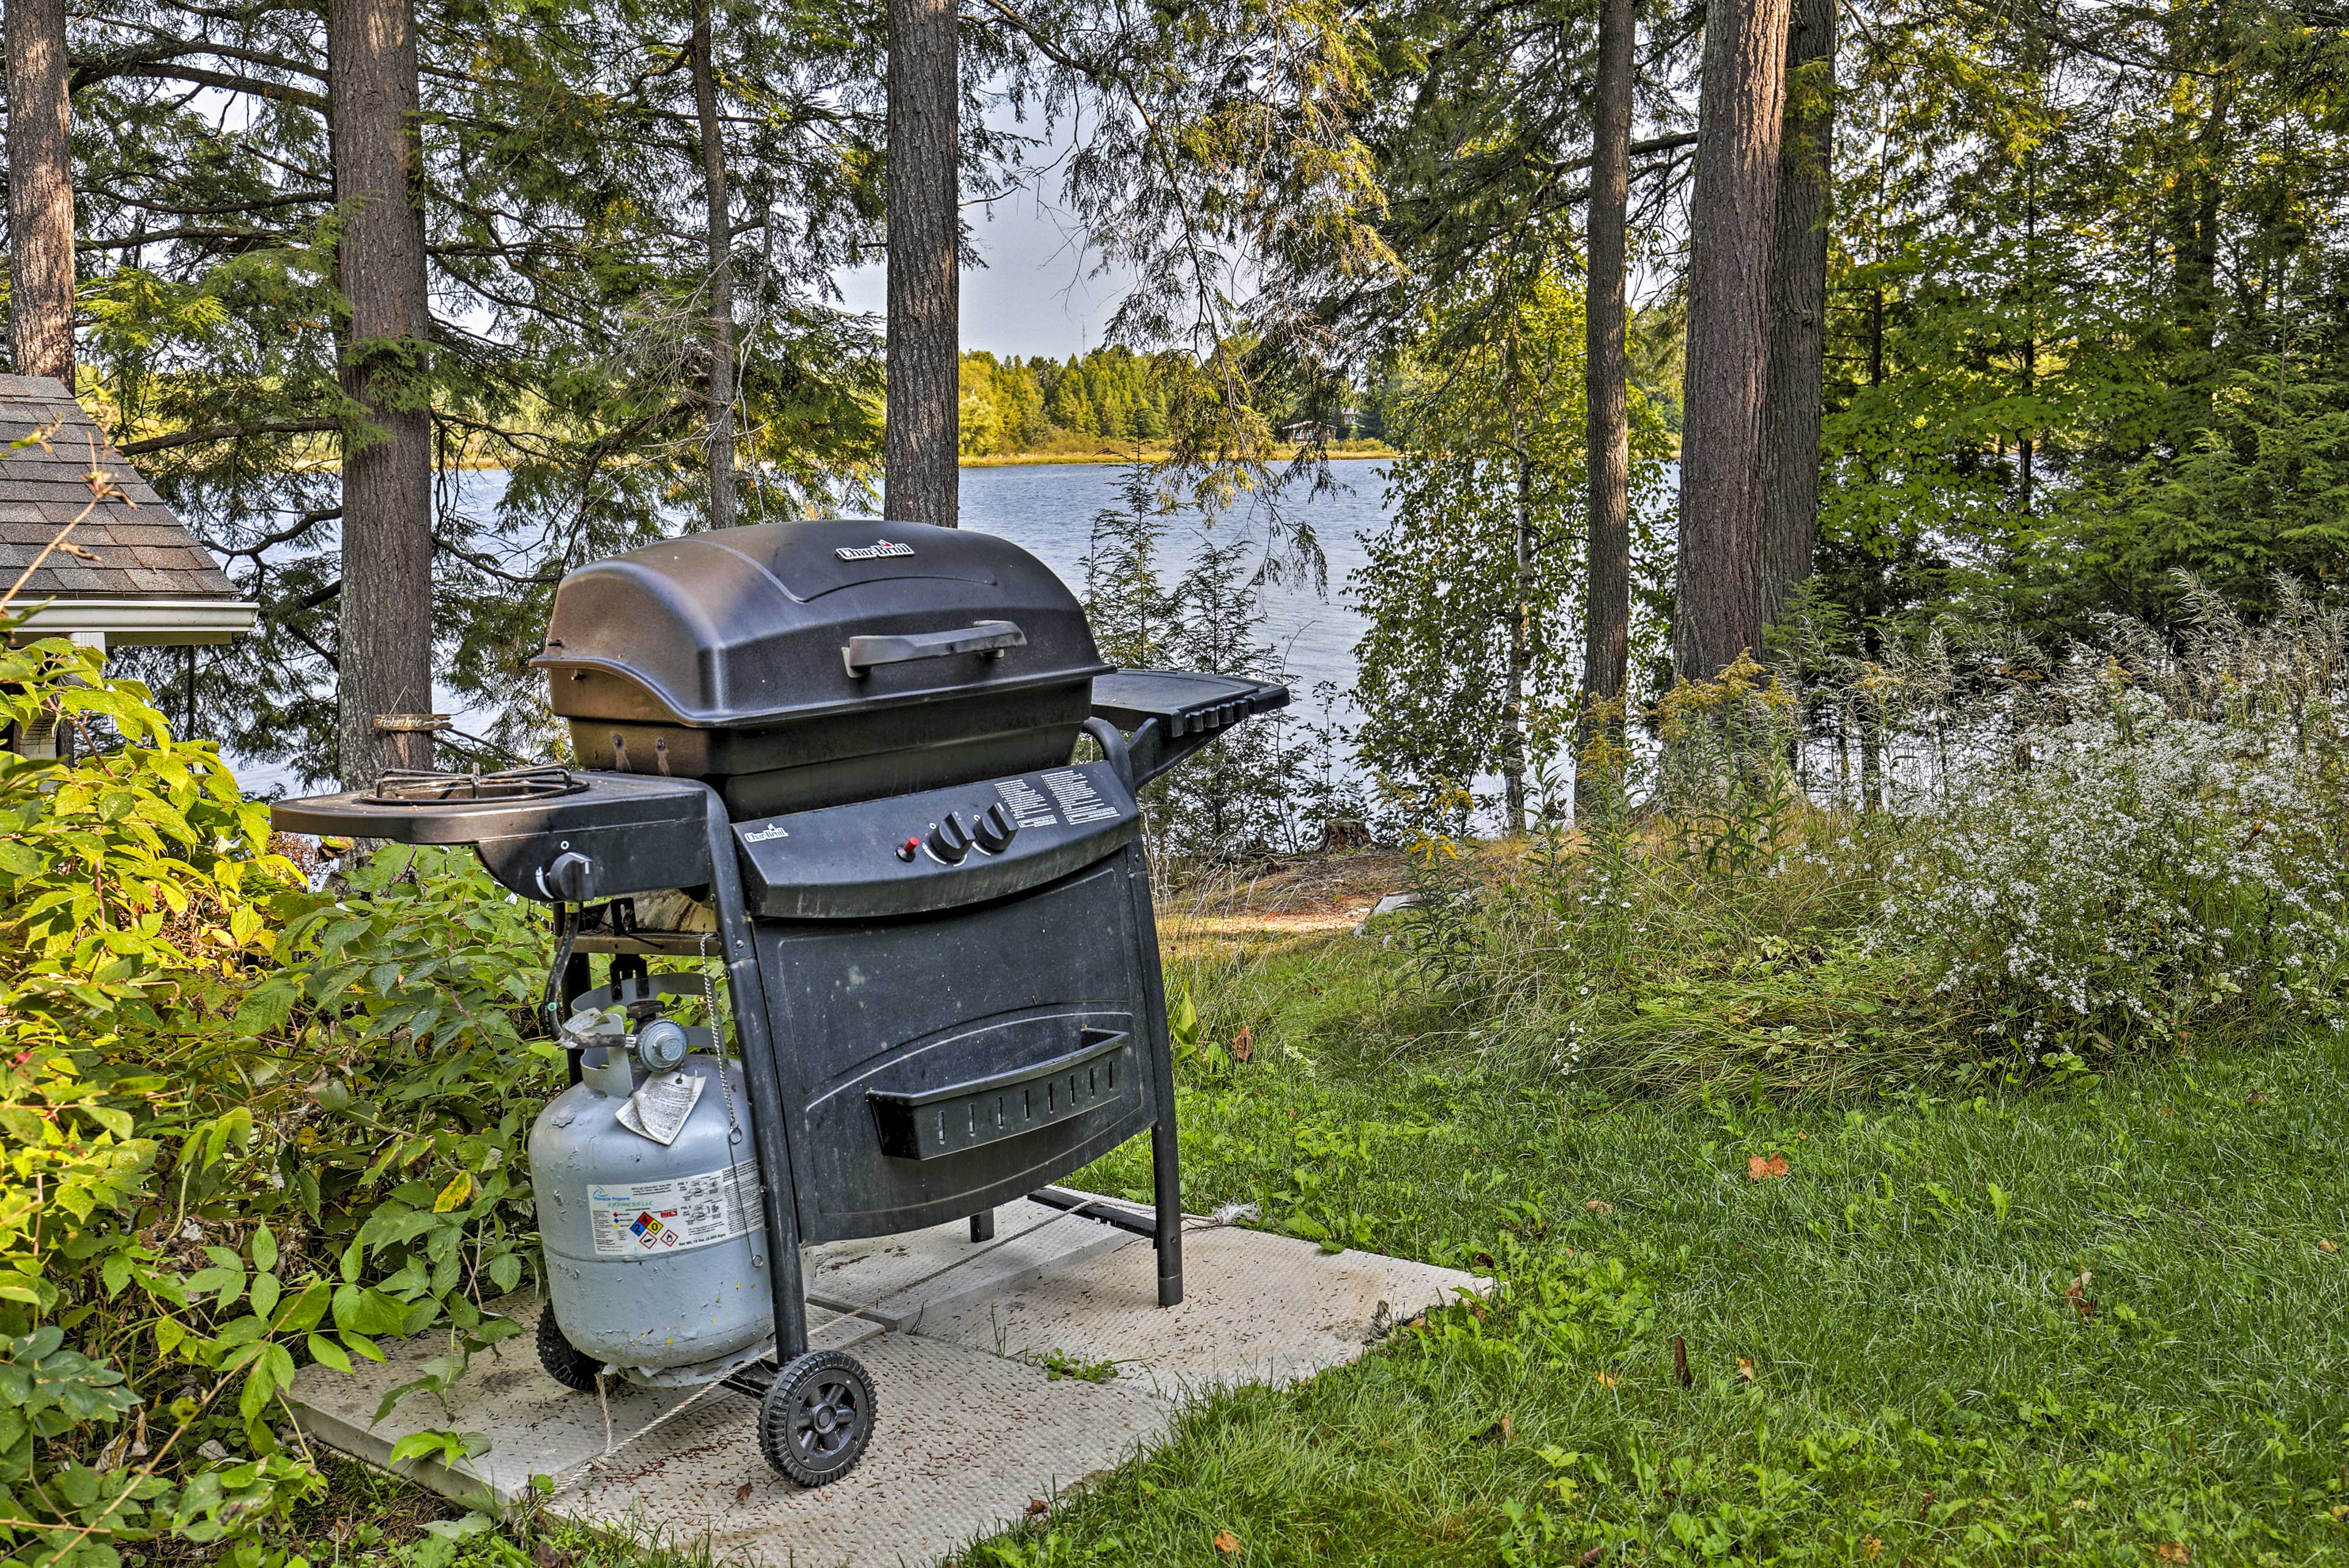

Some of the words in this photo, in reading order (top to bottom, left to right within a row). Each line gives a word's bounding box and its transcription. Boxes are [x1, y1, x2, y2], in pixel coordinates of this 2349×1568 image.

[837, 543, 911, 558] Char-Broil
[405, 716, 422, 727] hole
[641, 1215, 648, 1224] 4
[636, 1224, 641, 1232] 2
[651, 1222, 658, 1231] 0
